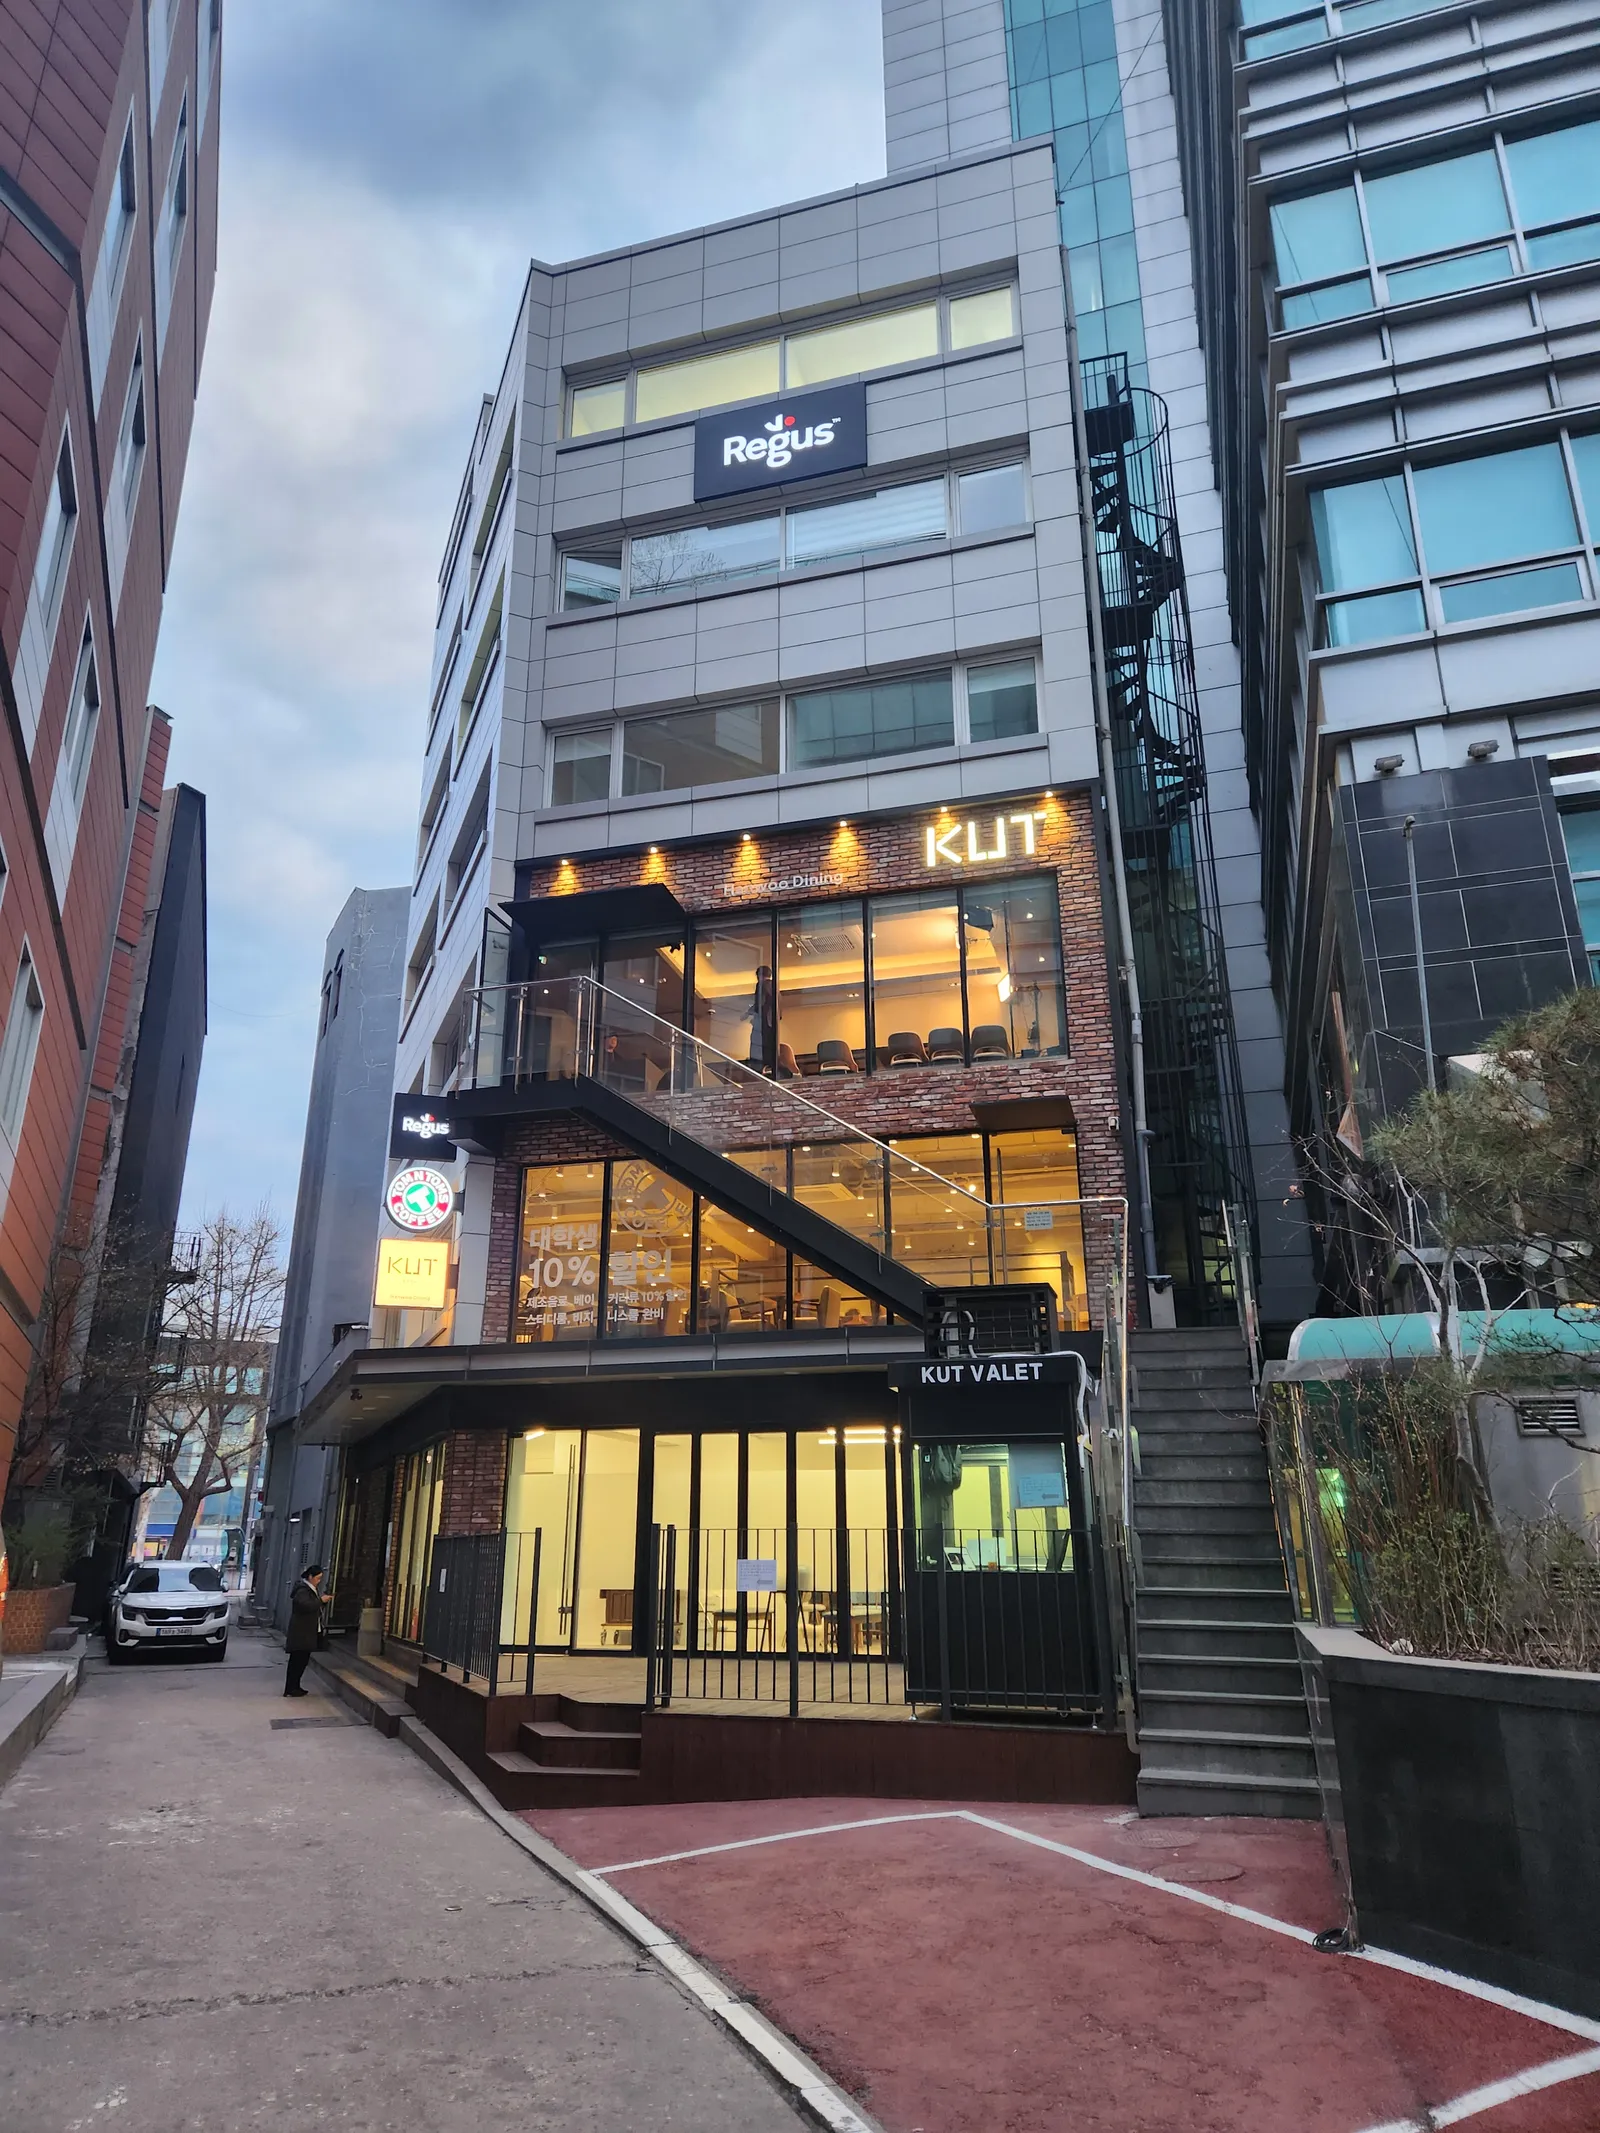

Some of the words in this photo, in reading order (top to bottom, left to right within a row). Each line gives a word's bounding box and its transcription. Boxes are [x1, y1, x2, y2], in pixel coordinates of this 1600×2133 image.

[723, 415, 835, 468] Regus
[926, 812, 1048, 867] KUT
[793, 872, 844, 888] Dining
[402, 1114, 450, 1139] Regus
[391, 1172, 412, 1197] TOM
[414, 1170, 425, 1181] N
[425, 1171, 449, 1203] TOMS
[393, 1203, 445, 1226] COFFEE
[529, 1223, 598, 1250] 대학생
[388, 1257, 438, 1275] KUT
[528, 1255, 596, 1288] 10%
[609, 1248, 673, 1286] 할인
[642, 1290, 665, 1303] 10%
[666, 1288, 688, 1302] 할인
[642, 1306, 664, 1321] 완비
[921, 1365, 964, 1384] KUT
[970, 1362, 1043, 1382] VALET
